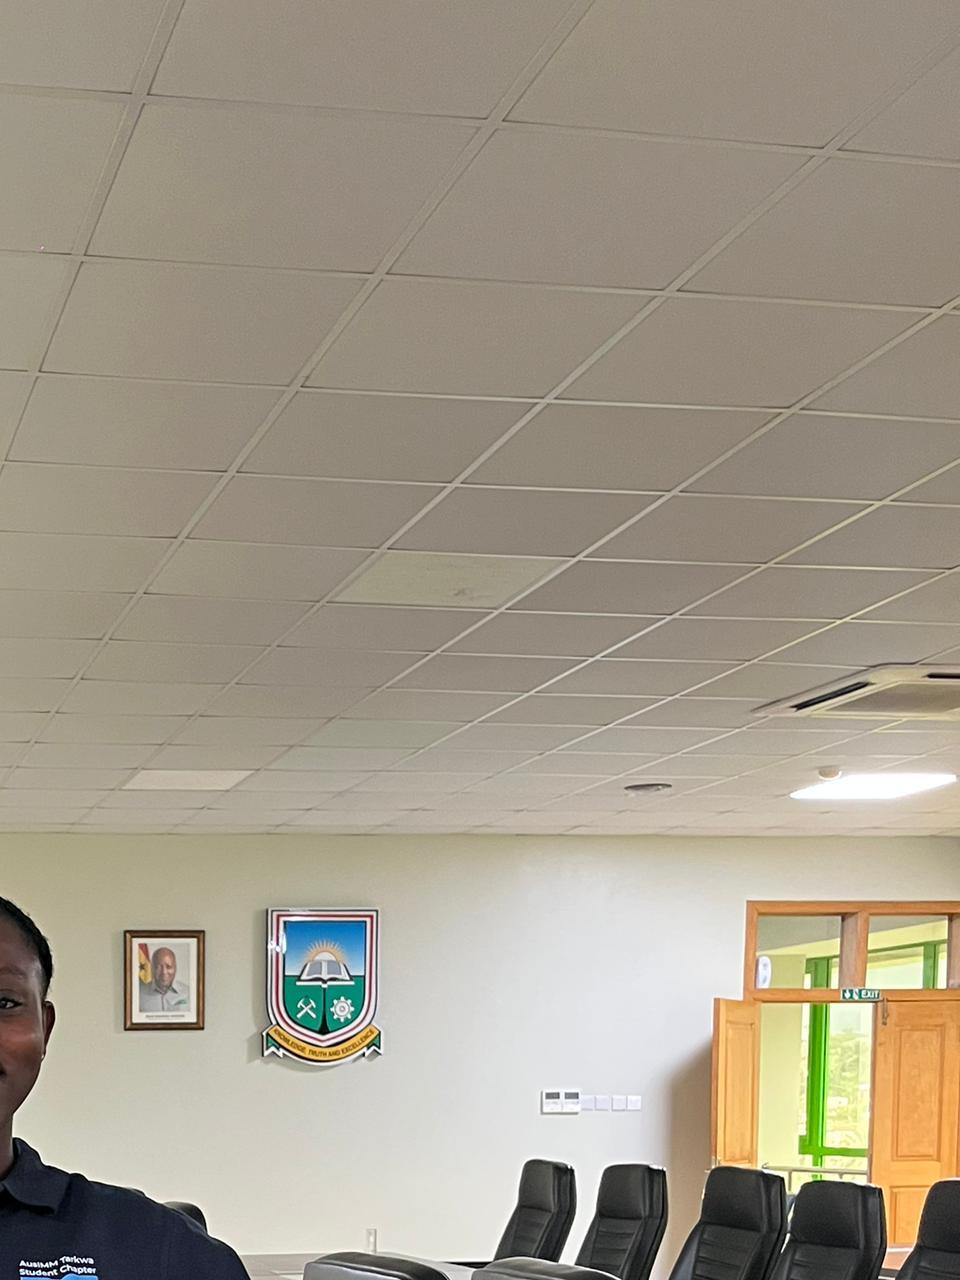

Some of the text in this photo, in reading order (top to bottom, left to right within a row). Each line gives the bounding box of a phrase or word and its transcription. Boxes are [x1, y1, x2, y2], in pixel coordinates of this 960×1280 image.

[861, 989, 879, 998] EXIT
[60, 1255, 95, 1265] Tarkwa
[19, 1263, 97, 1277] Student Chapter
